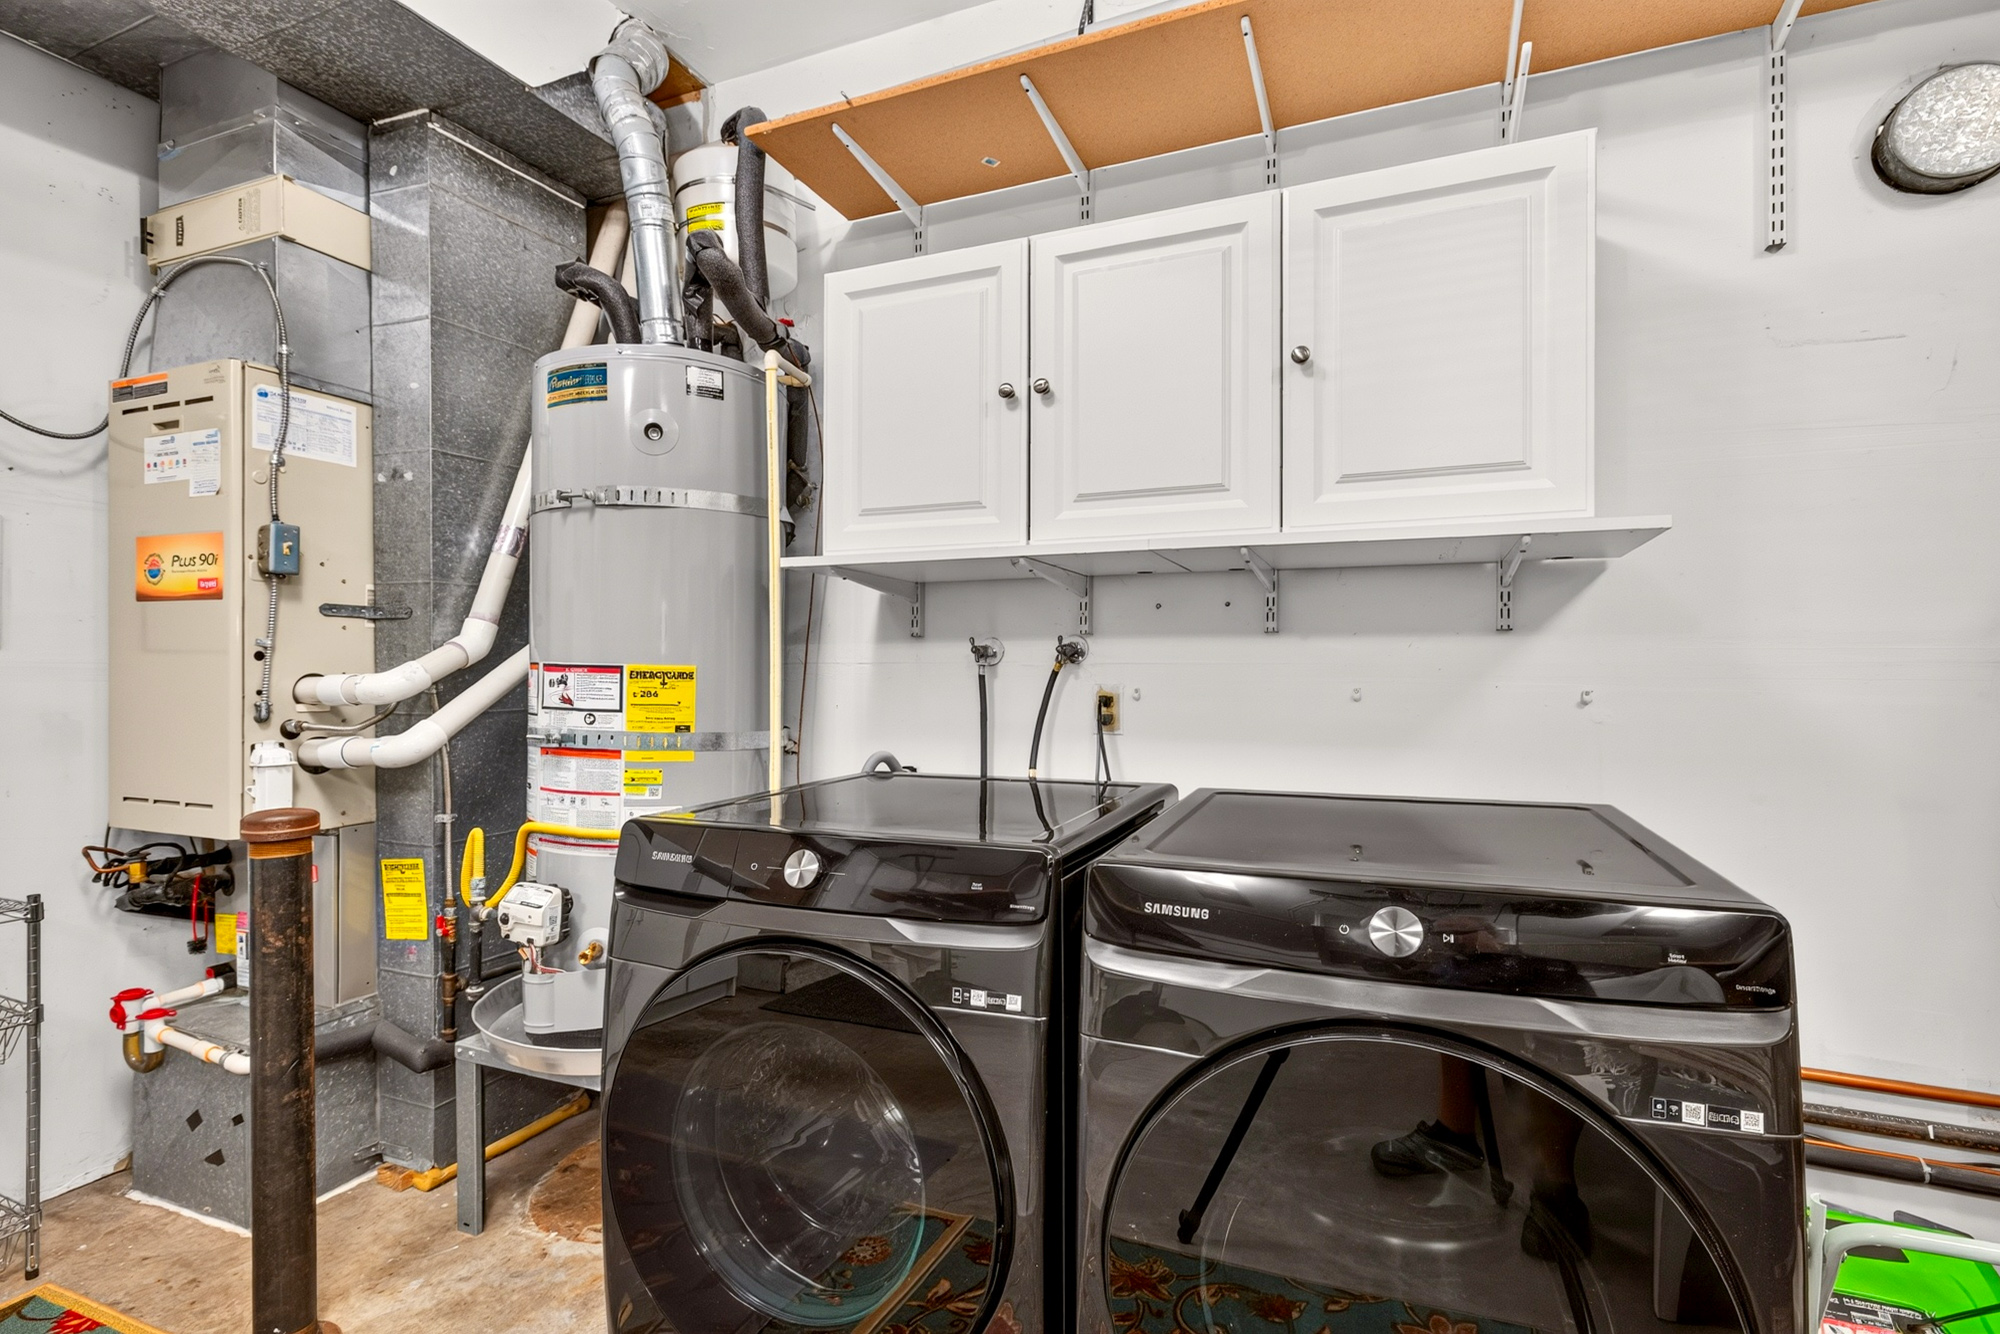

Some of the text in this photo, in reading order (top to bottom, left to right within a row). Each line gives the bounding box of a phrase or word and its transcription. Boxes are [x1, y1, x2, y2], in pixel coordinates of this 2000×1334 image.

[199, 552, 219, 566] 90i
[652, 851, 693, 863] SAMSUNG
[1144, 902, 1209, 920] SAMSUNG
